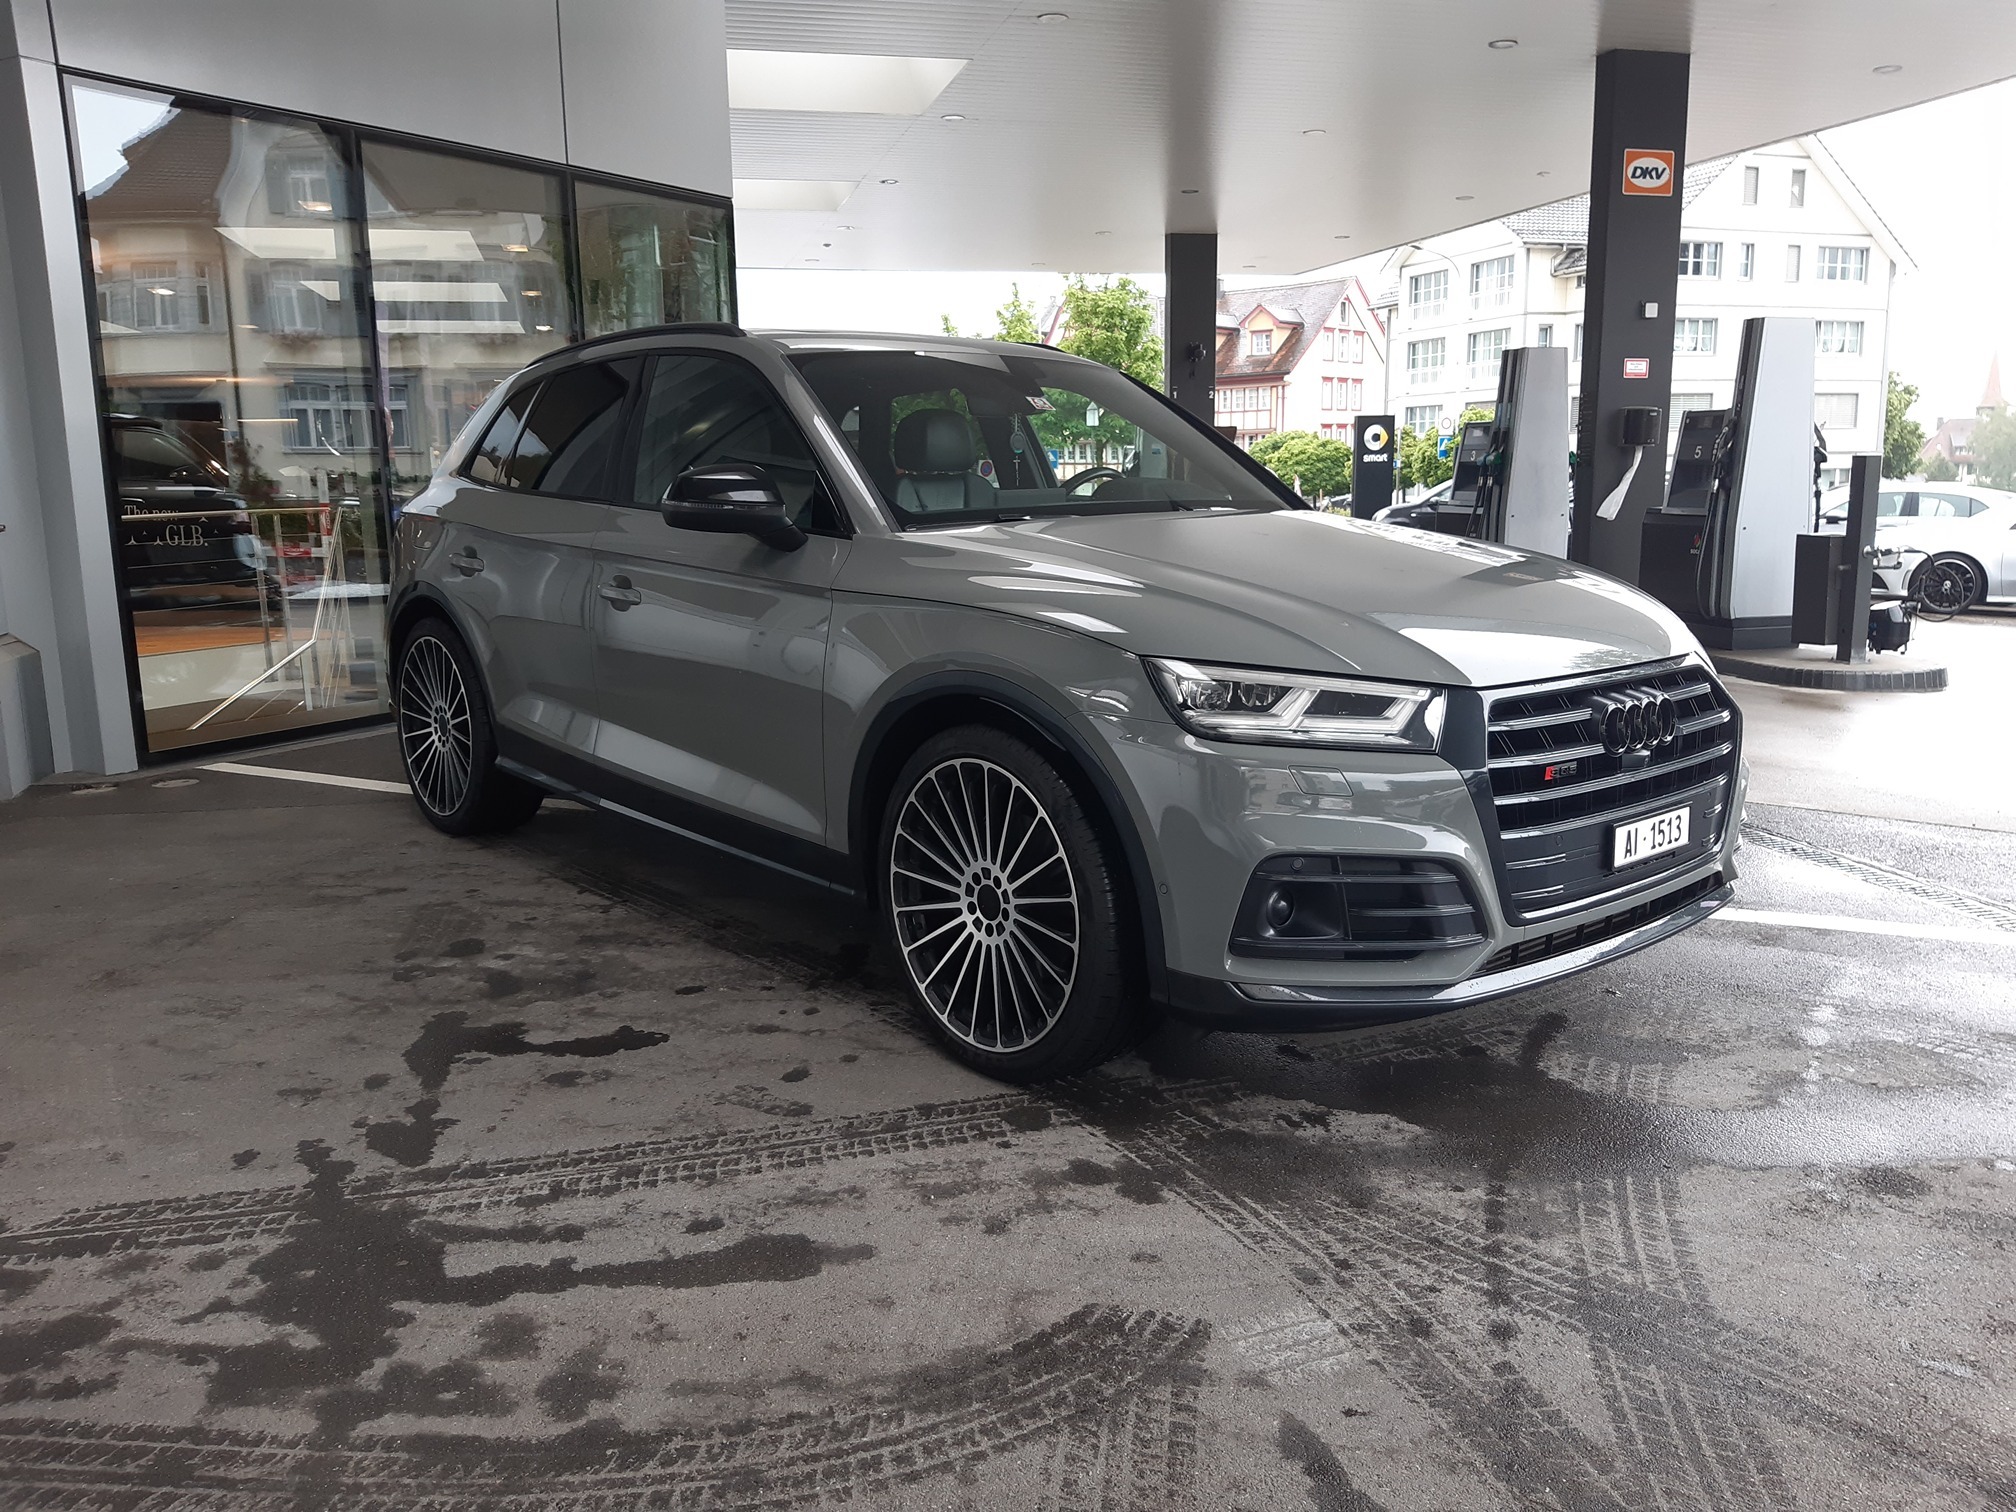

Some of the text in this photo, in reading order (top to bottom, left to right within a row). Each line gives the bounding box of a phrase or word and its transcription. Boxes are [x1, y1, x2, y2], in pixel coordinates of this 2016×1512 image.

[1631, 166, 1667, 180] DKV
[1208, 391, 1214, 399] 2
[1363, 453, 1388, 463] smart
[1470, 450, 1476, 461] 3
[1694, 445, 1702, 459] 5
[165, 524, 209, 547] GLB.
